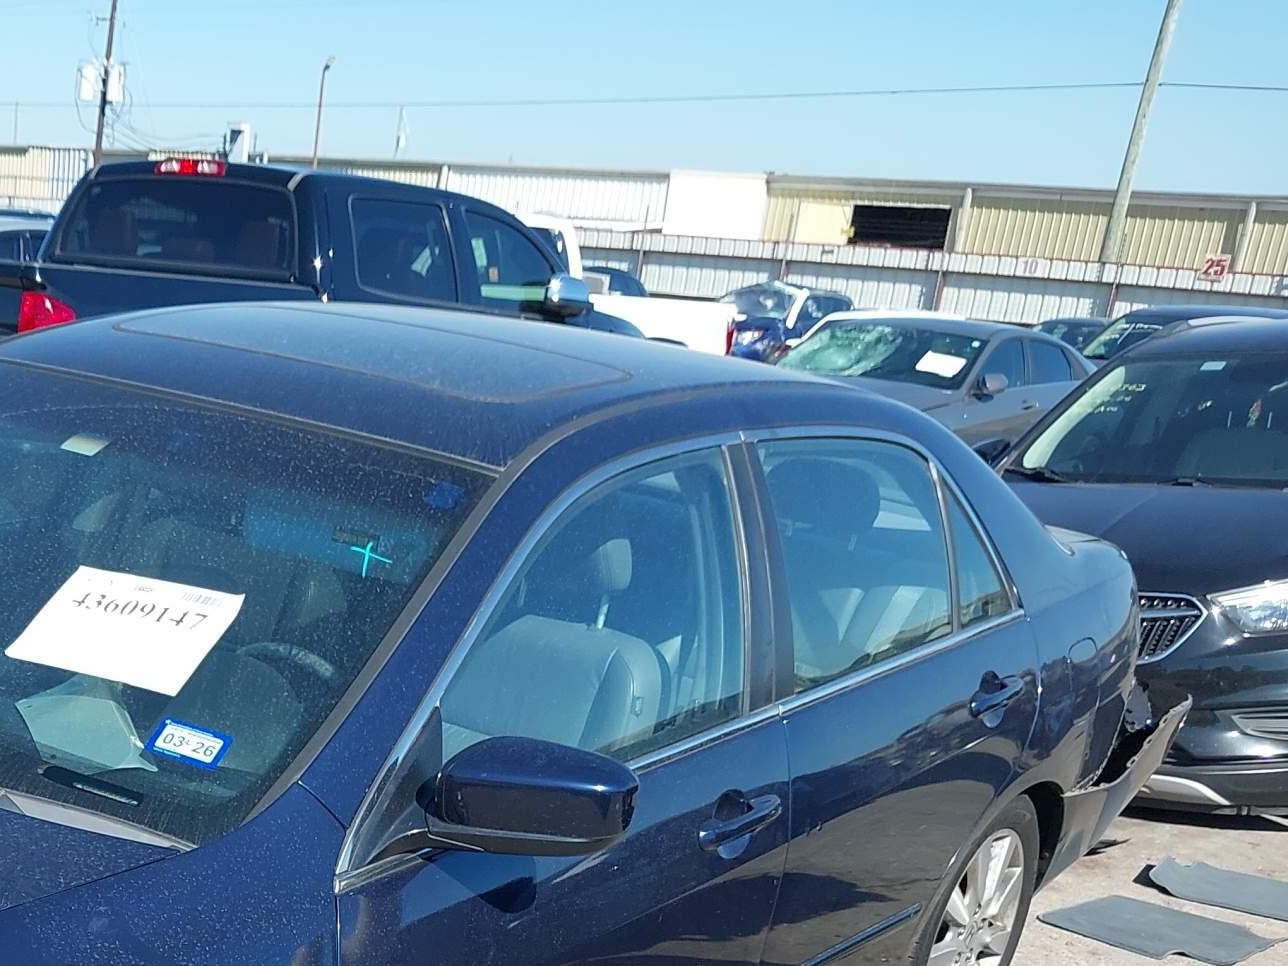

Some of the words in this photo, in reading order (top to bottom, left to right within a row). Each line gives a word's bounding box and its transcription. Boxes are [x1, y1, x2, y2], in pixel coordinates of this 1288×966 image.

[1202, 259, 1227, 276] 25
[72, 592, 208, 629] 43609147
[192, 741, 216, 757] 26
